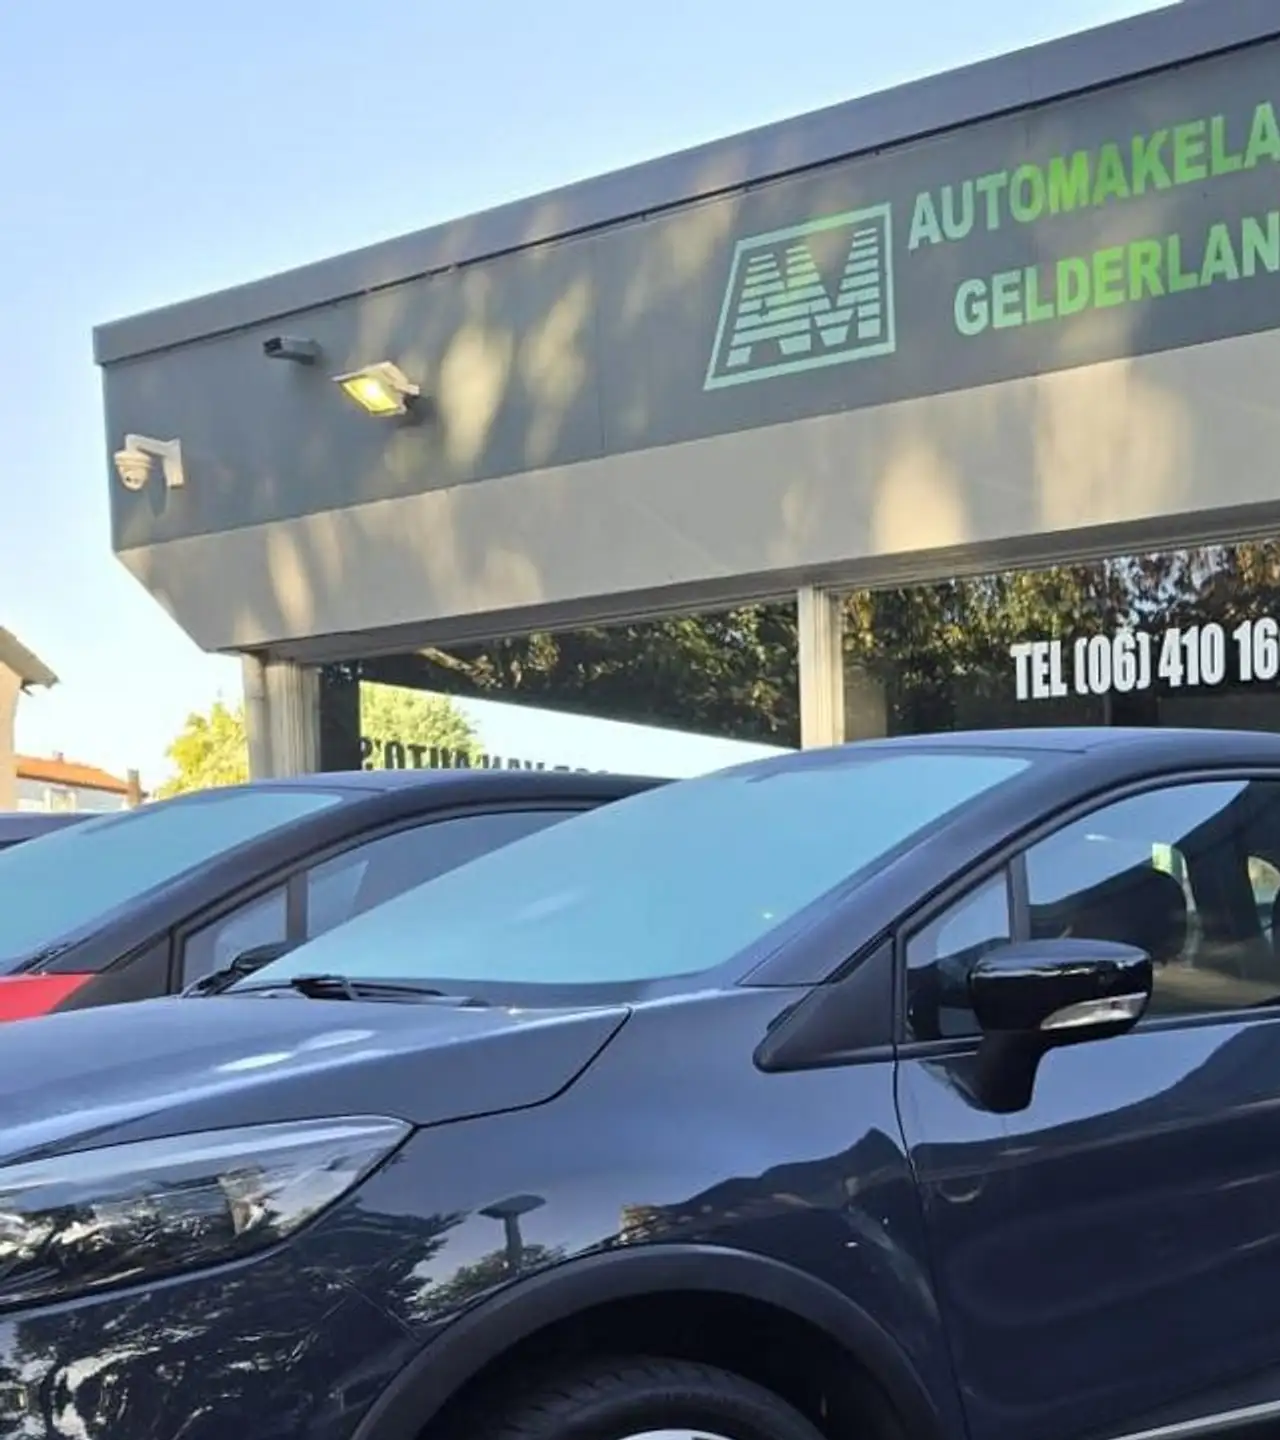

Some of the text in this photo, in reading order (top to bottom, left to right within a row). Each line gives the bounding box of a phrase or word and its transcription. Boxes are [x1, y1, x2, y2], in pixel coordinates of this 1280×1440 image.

[727, 226, 881, 367] AM
[1010, 641, 1067, 699] TEL
[1075, 633, 1151, 693] (06)
[1159, 624, 1226, 687] 410
